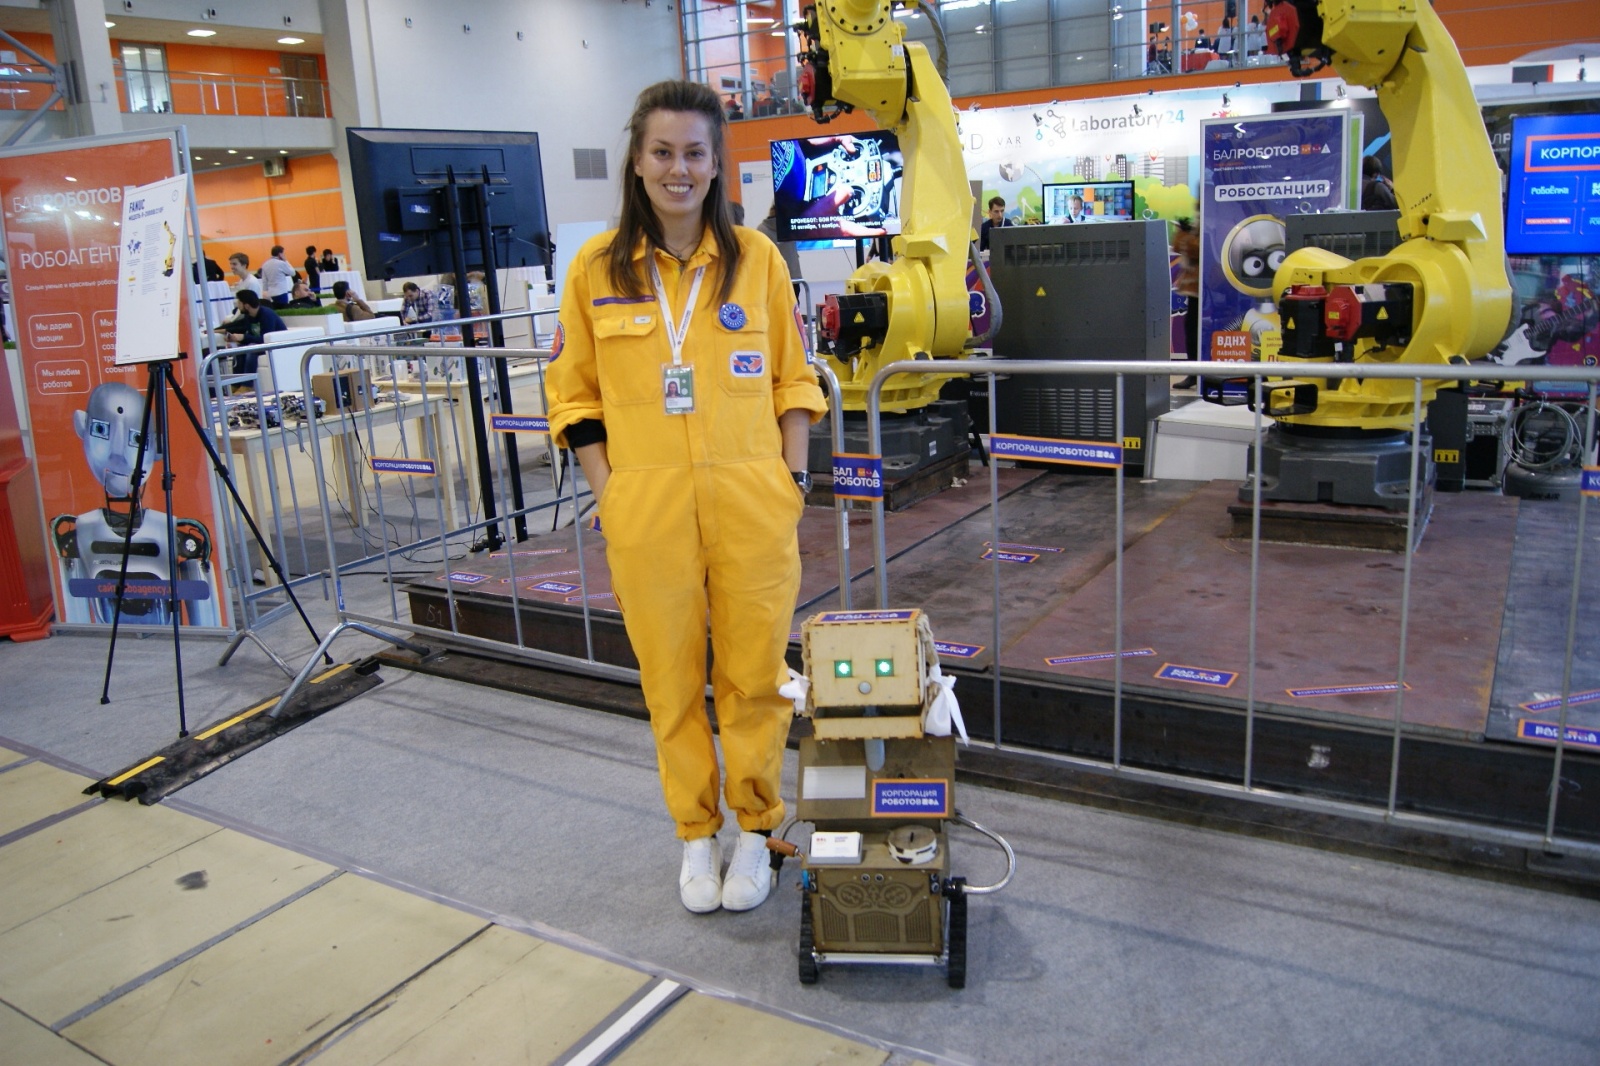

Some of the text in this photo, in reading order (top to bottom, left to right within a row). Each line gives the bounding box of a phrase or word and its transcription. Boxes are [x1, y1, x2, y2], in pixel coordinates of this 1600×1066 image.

[1213, 145, 1299, 161] БАЛРОБОТОВ
[1219, 183, 1326, 199] РОБОСТАНЦИЯ
[35, 322, 73, 331] Мы дарим
[99, 319, 113, 327] Мы
[1217, 335, 1246, 348] ВДНХ
[41, 367, 81, 377] Мы любим
[42, 379, 73, 389] роботов
[832, 466, 853, 477] БАЛ
[833, 475, 881, 488] РОБОТОВ
[881, 790, 938, 798] КОРПОРАЦИЯ
[881, 798, 922, 806] РОБОТОВ
